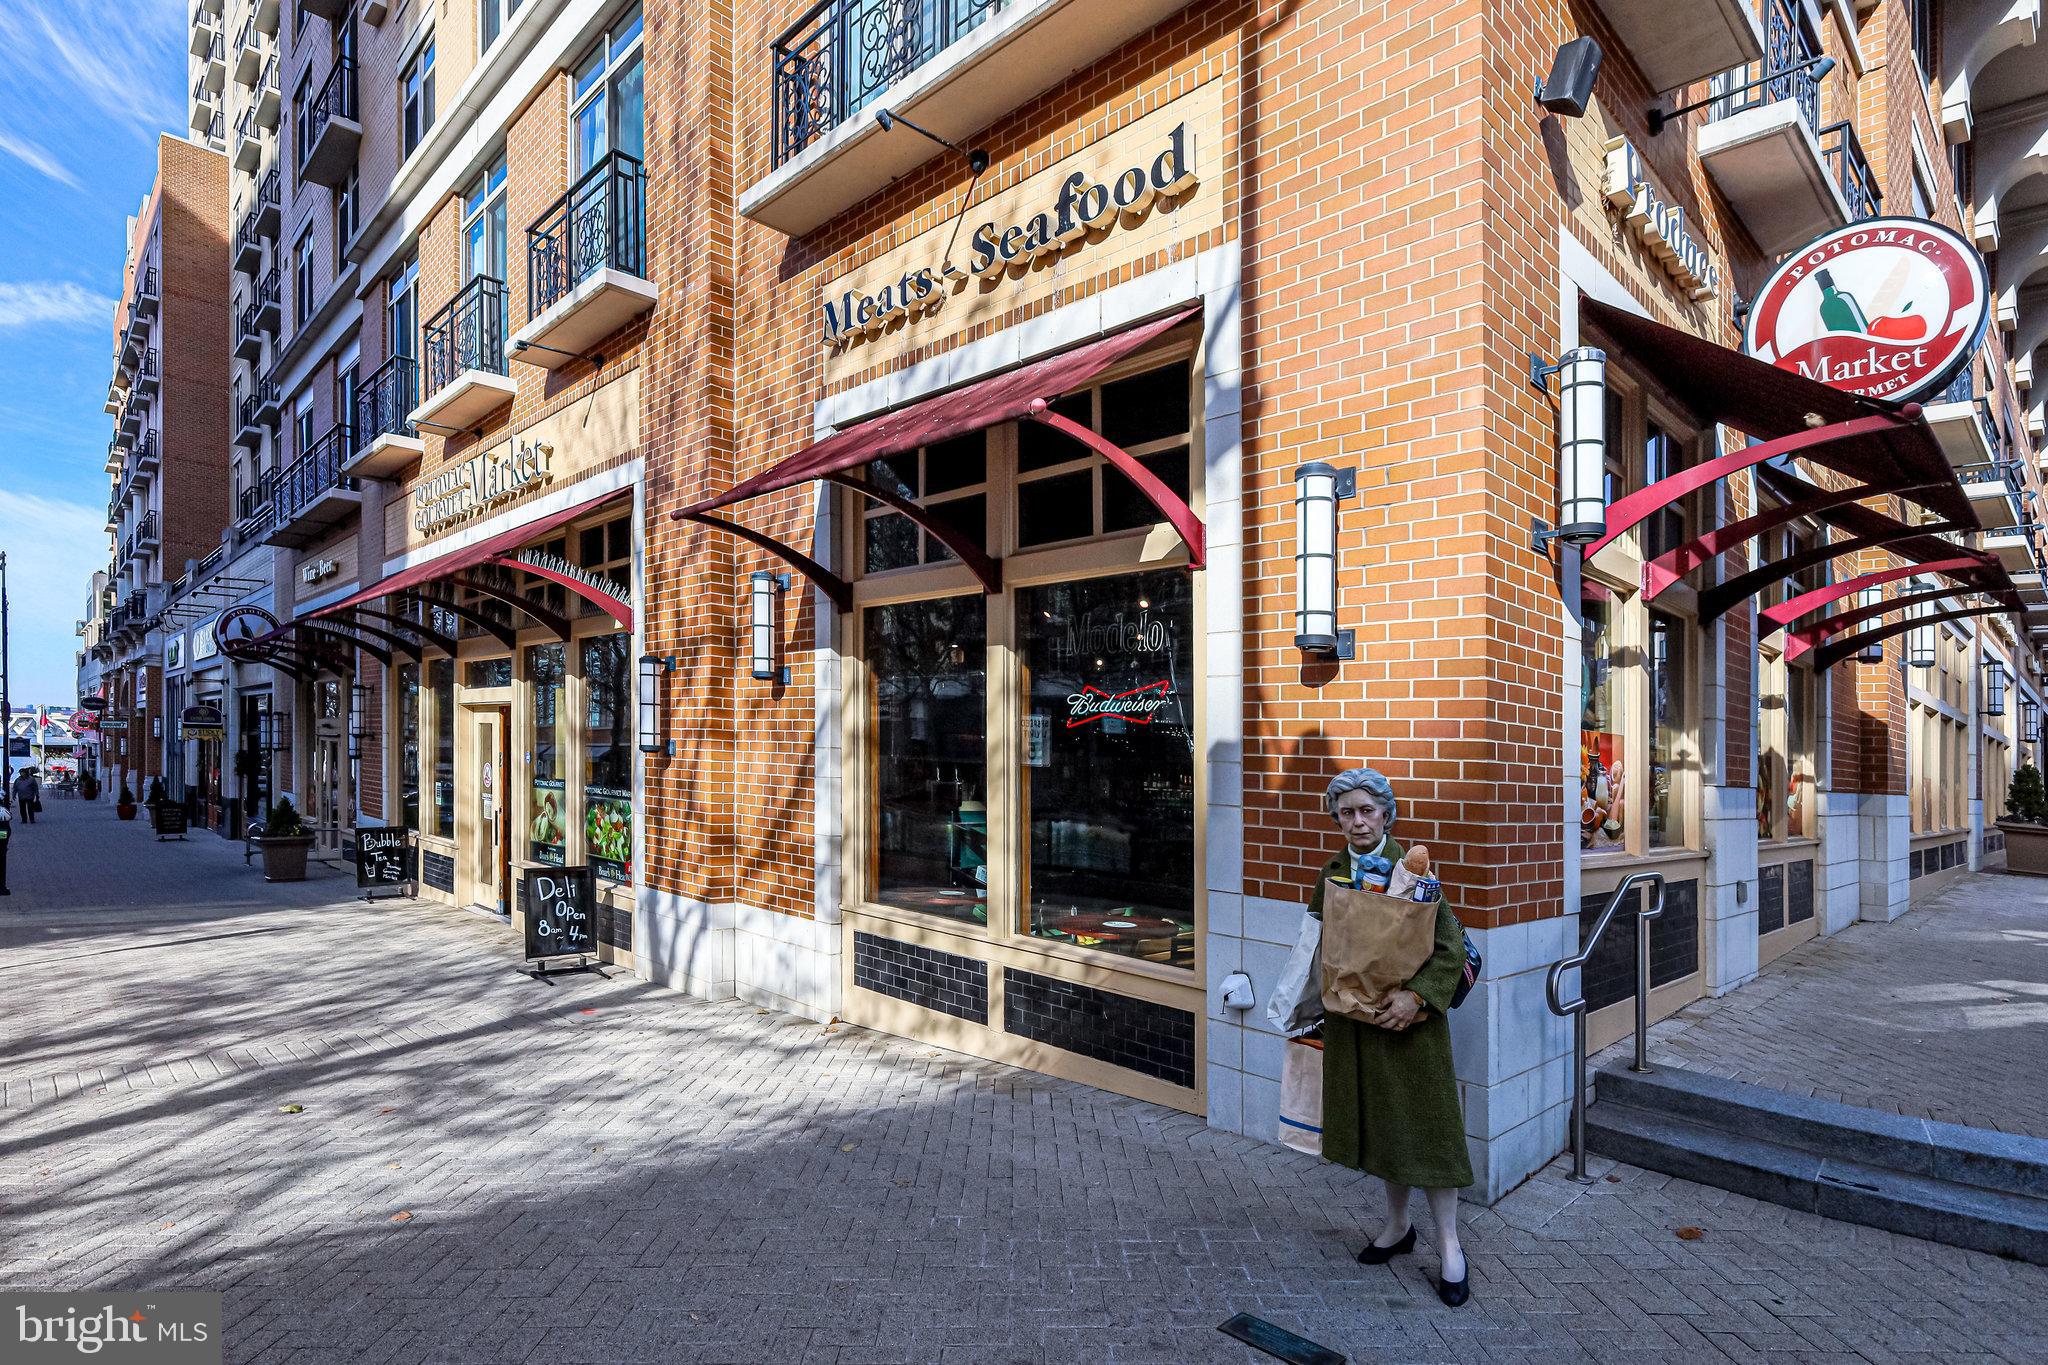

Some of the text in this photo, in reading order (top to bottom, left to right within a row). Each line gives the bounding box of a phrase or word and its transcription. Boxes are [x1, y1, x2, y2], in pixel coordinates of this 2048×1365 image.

[822, 265, 938, 345] Meats
[970, 121, 1194, 276] Seafood
[1614, 134, 1720, 299] Produce
[1789, 229, 1938, 281] POTOMAC
[1796, 346, 1928, 384] Market
[415, 463, 468, 508] POTOMAC
[469, 435, 542, 506] Market
[414, 489, 466, 531] GOURMET
[1066, 609, 1164, 656] Modelo
[1066, 693, 1164, 715] Budweiser
[361, 833, 401, 851] Bubble
[370, 851, 388, 862] Tea
[537, 875, 576, 901] Deli
[555, 900, 586, 921] Open
